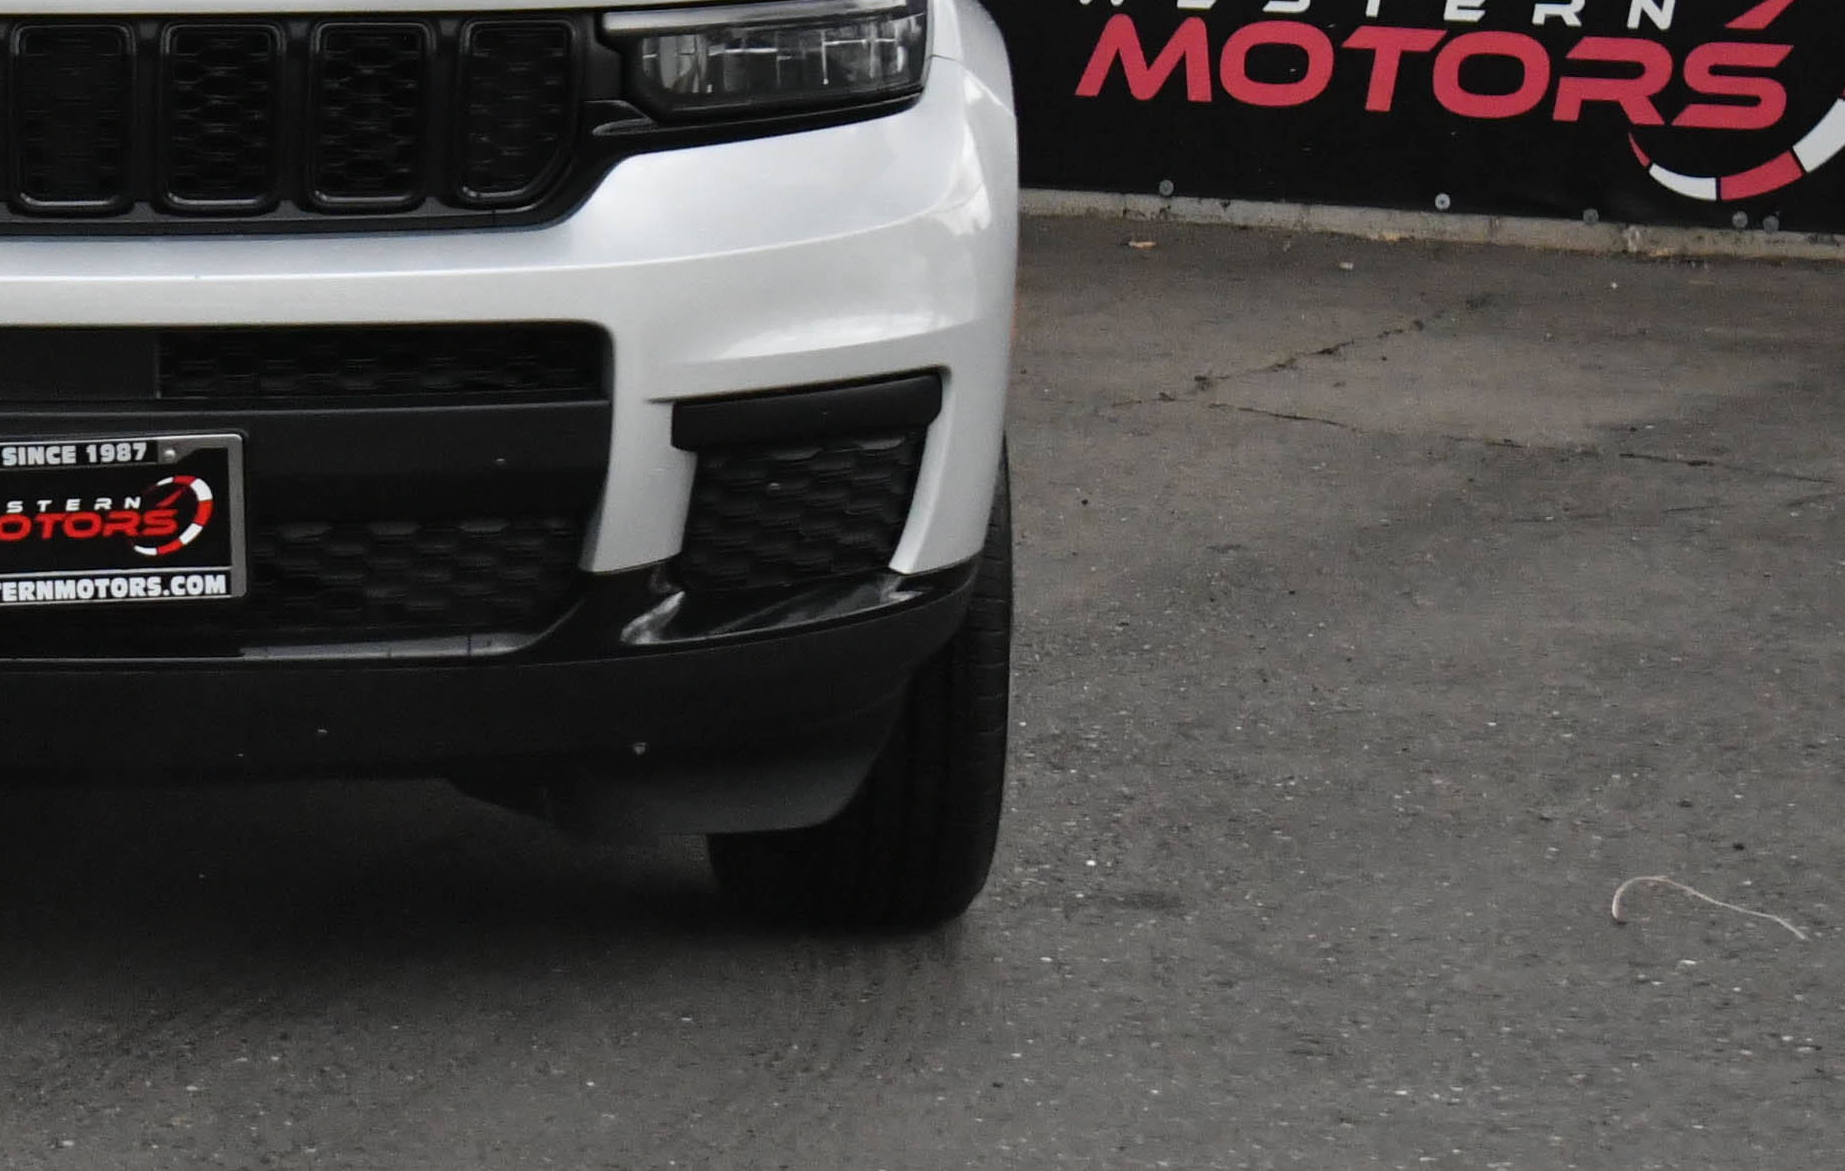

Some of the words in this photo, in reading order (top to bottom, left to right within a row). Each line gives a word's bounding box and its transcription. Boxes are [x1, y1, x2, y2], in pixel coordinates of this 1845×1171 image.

[1073, 12, 1795, 130] MOTORS
[1, 445, 77, 467] SINCE
[86, 442, 147, 463] 1987
